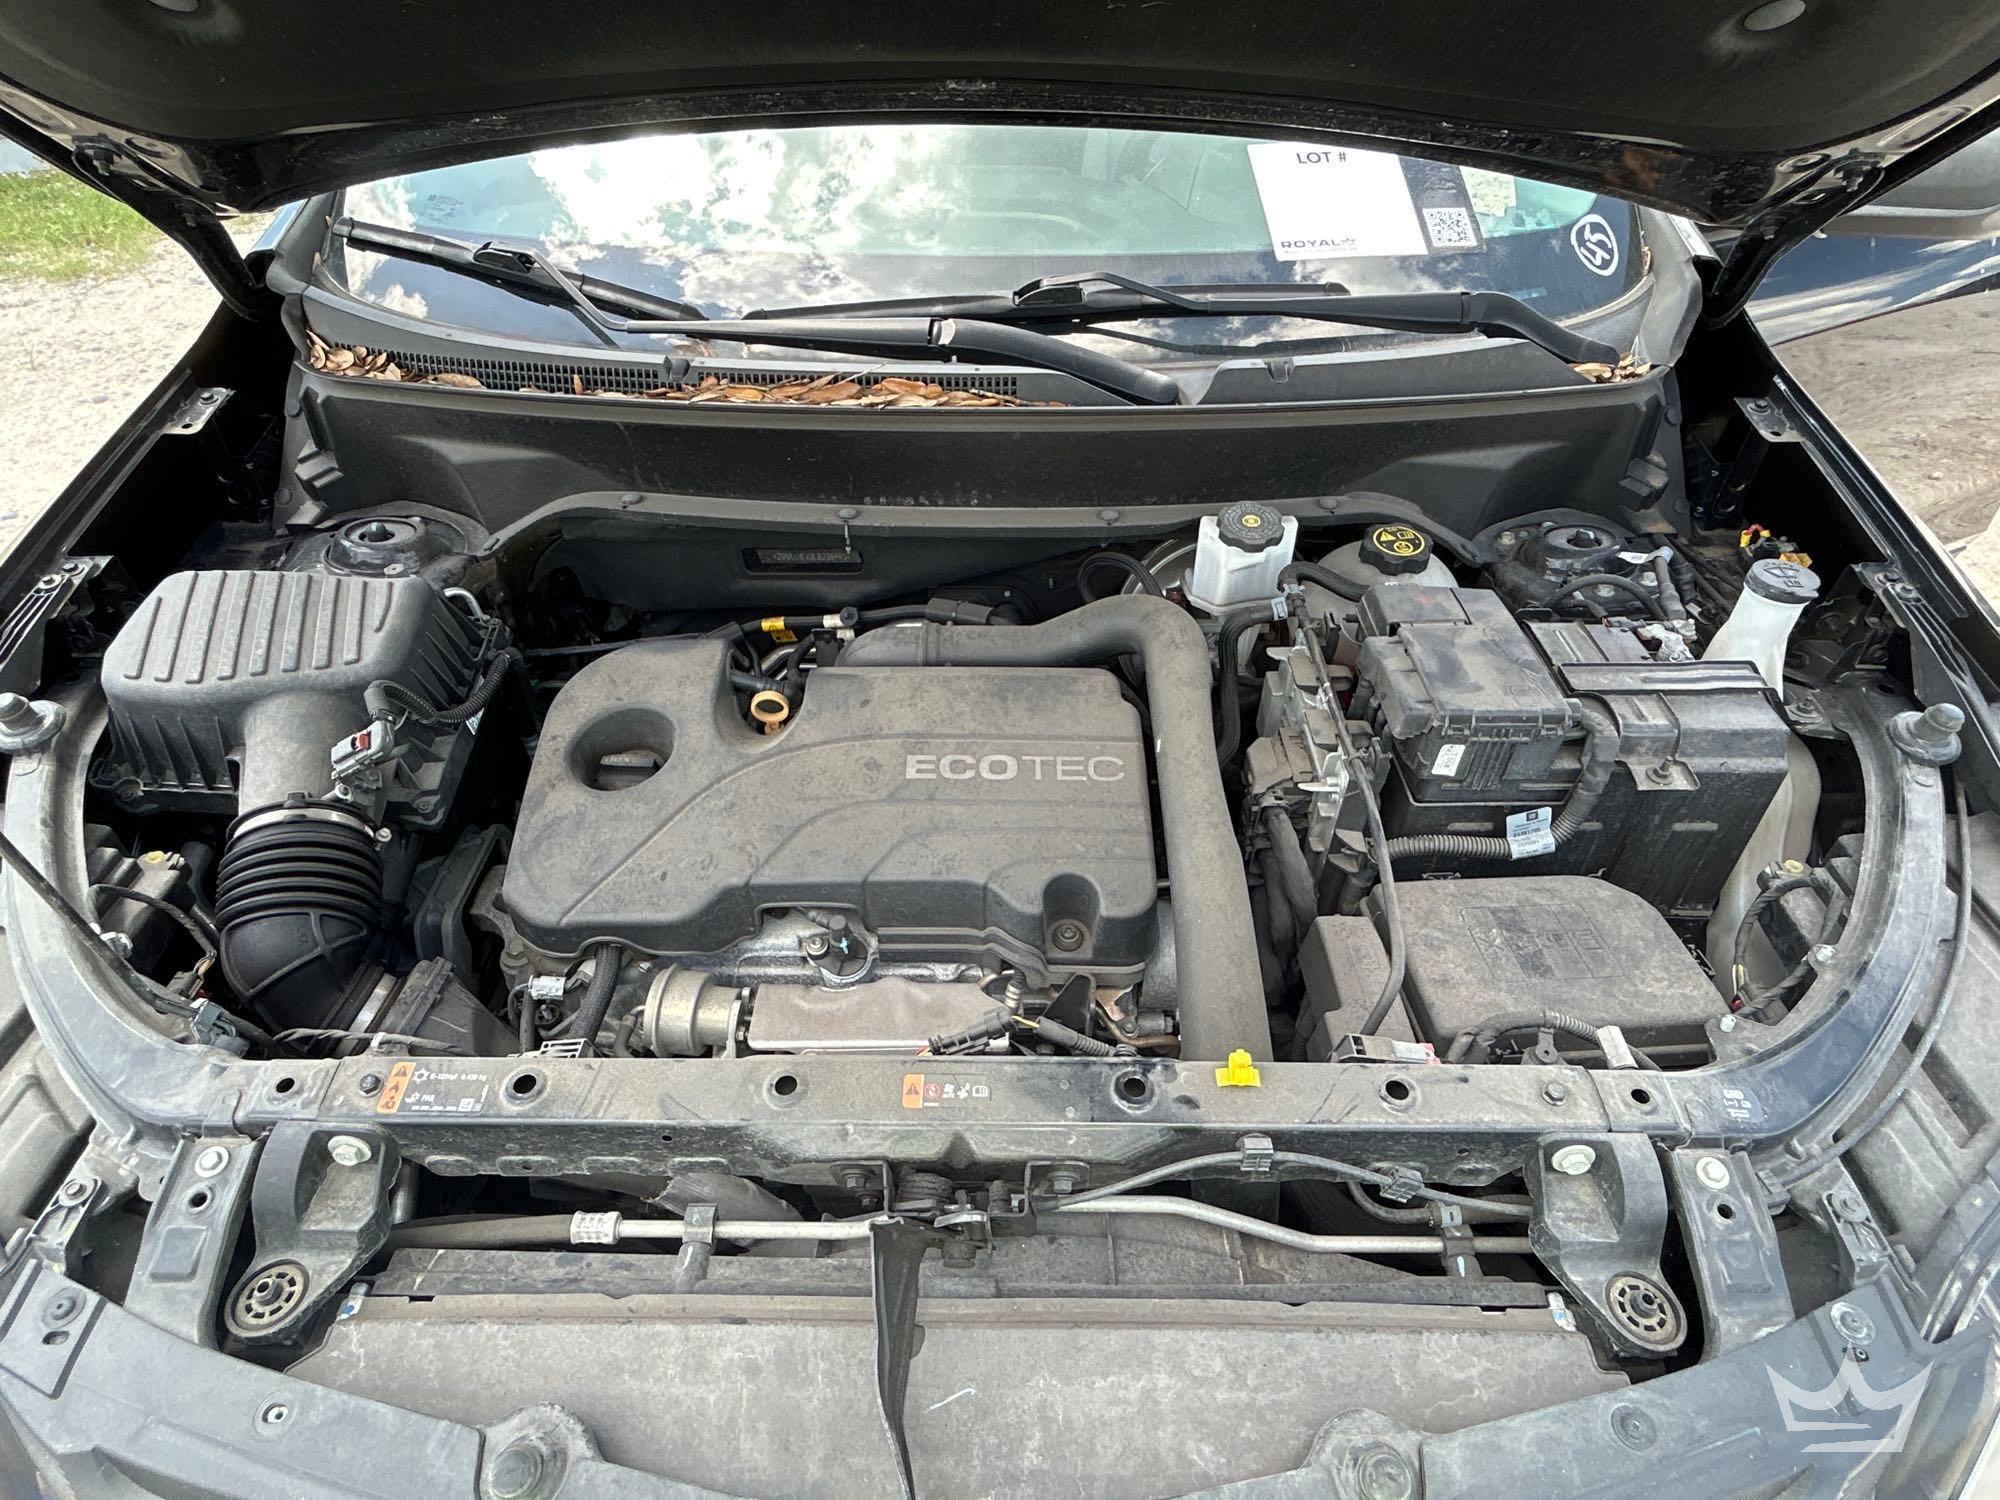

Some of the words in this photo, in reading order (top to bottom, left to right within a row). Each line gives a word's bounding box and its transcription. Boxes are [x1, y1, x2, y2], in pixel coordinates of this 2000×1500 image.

[1296, 151, 1331, 164] LOT
[1338, 151, 1346, 163] #
[1280, 239, 1341, 249] ROYAL
[905, 754, 1126, 782] ECOTEC
